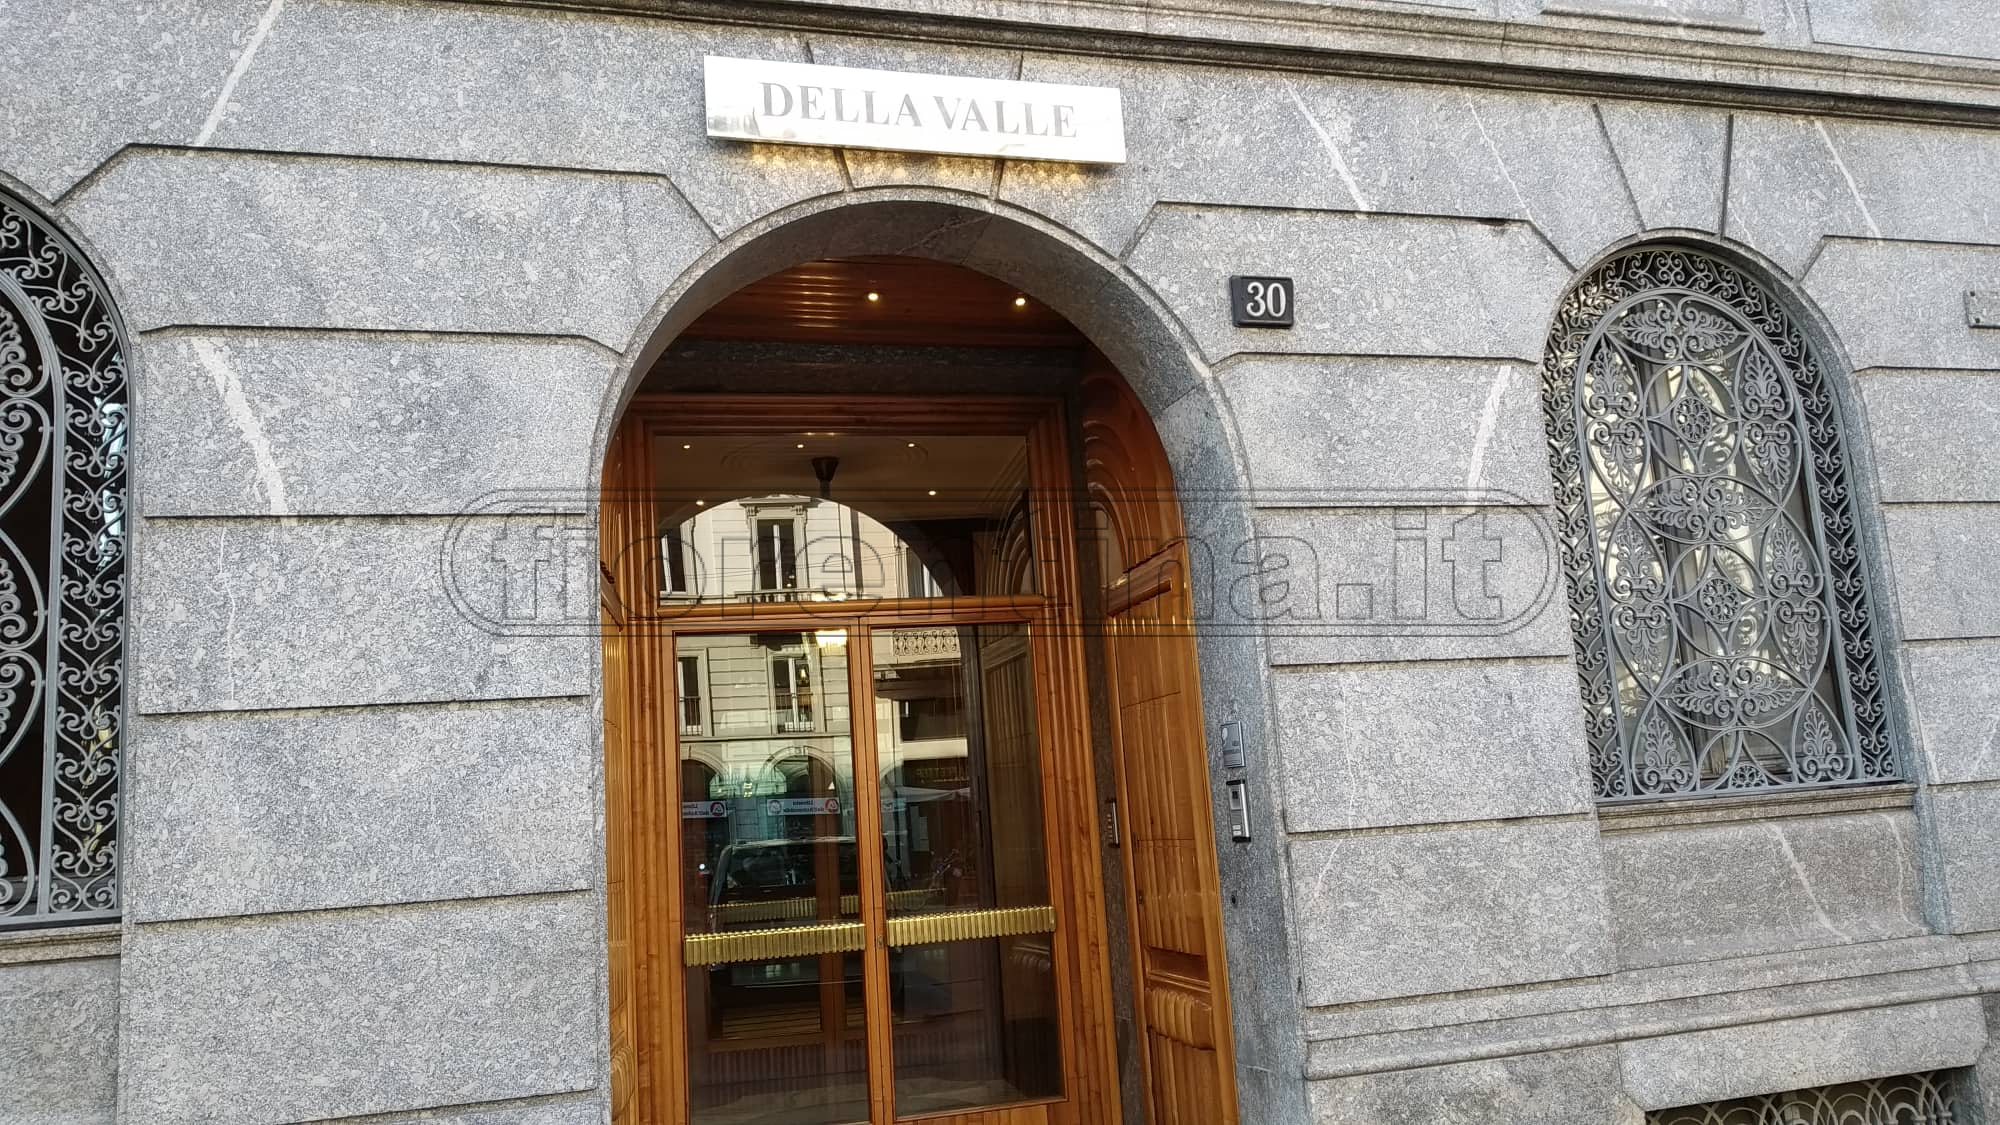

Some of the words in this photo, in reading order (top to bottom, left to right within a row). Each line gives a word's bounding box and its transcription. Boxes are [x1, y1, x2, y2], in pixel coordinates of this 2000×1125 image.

[759, 82, 922, 127] DELLA
[933, 95, 1077, 138] VALLE
[1246, 281, 1286, 317] 30
